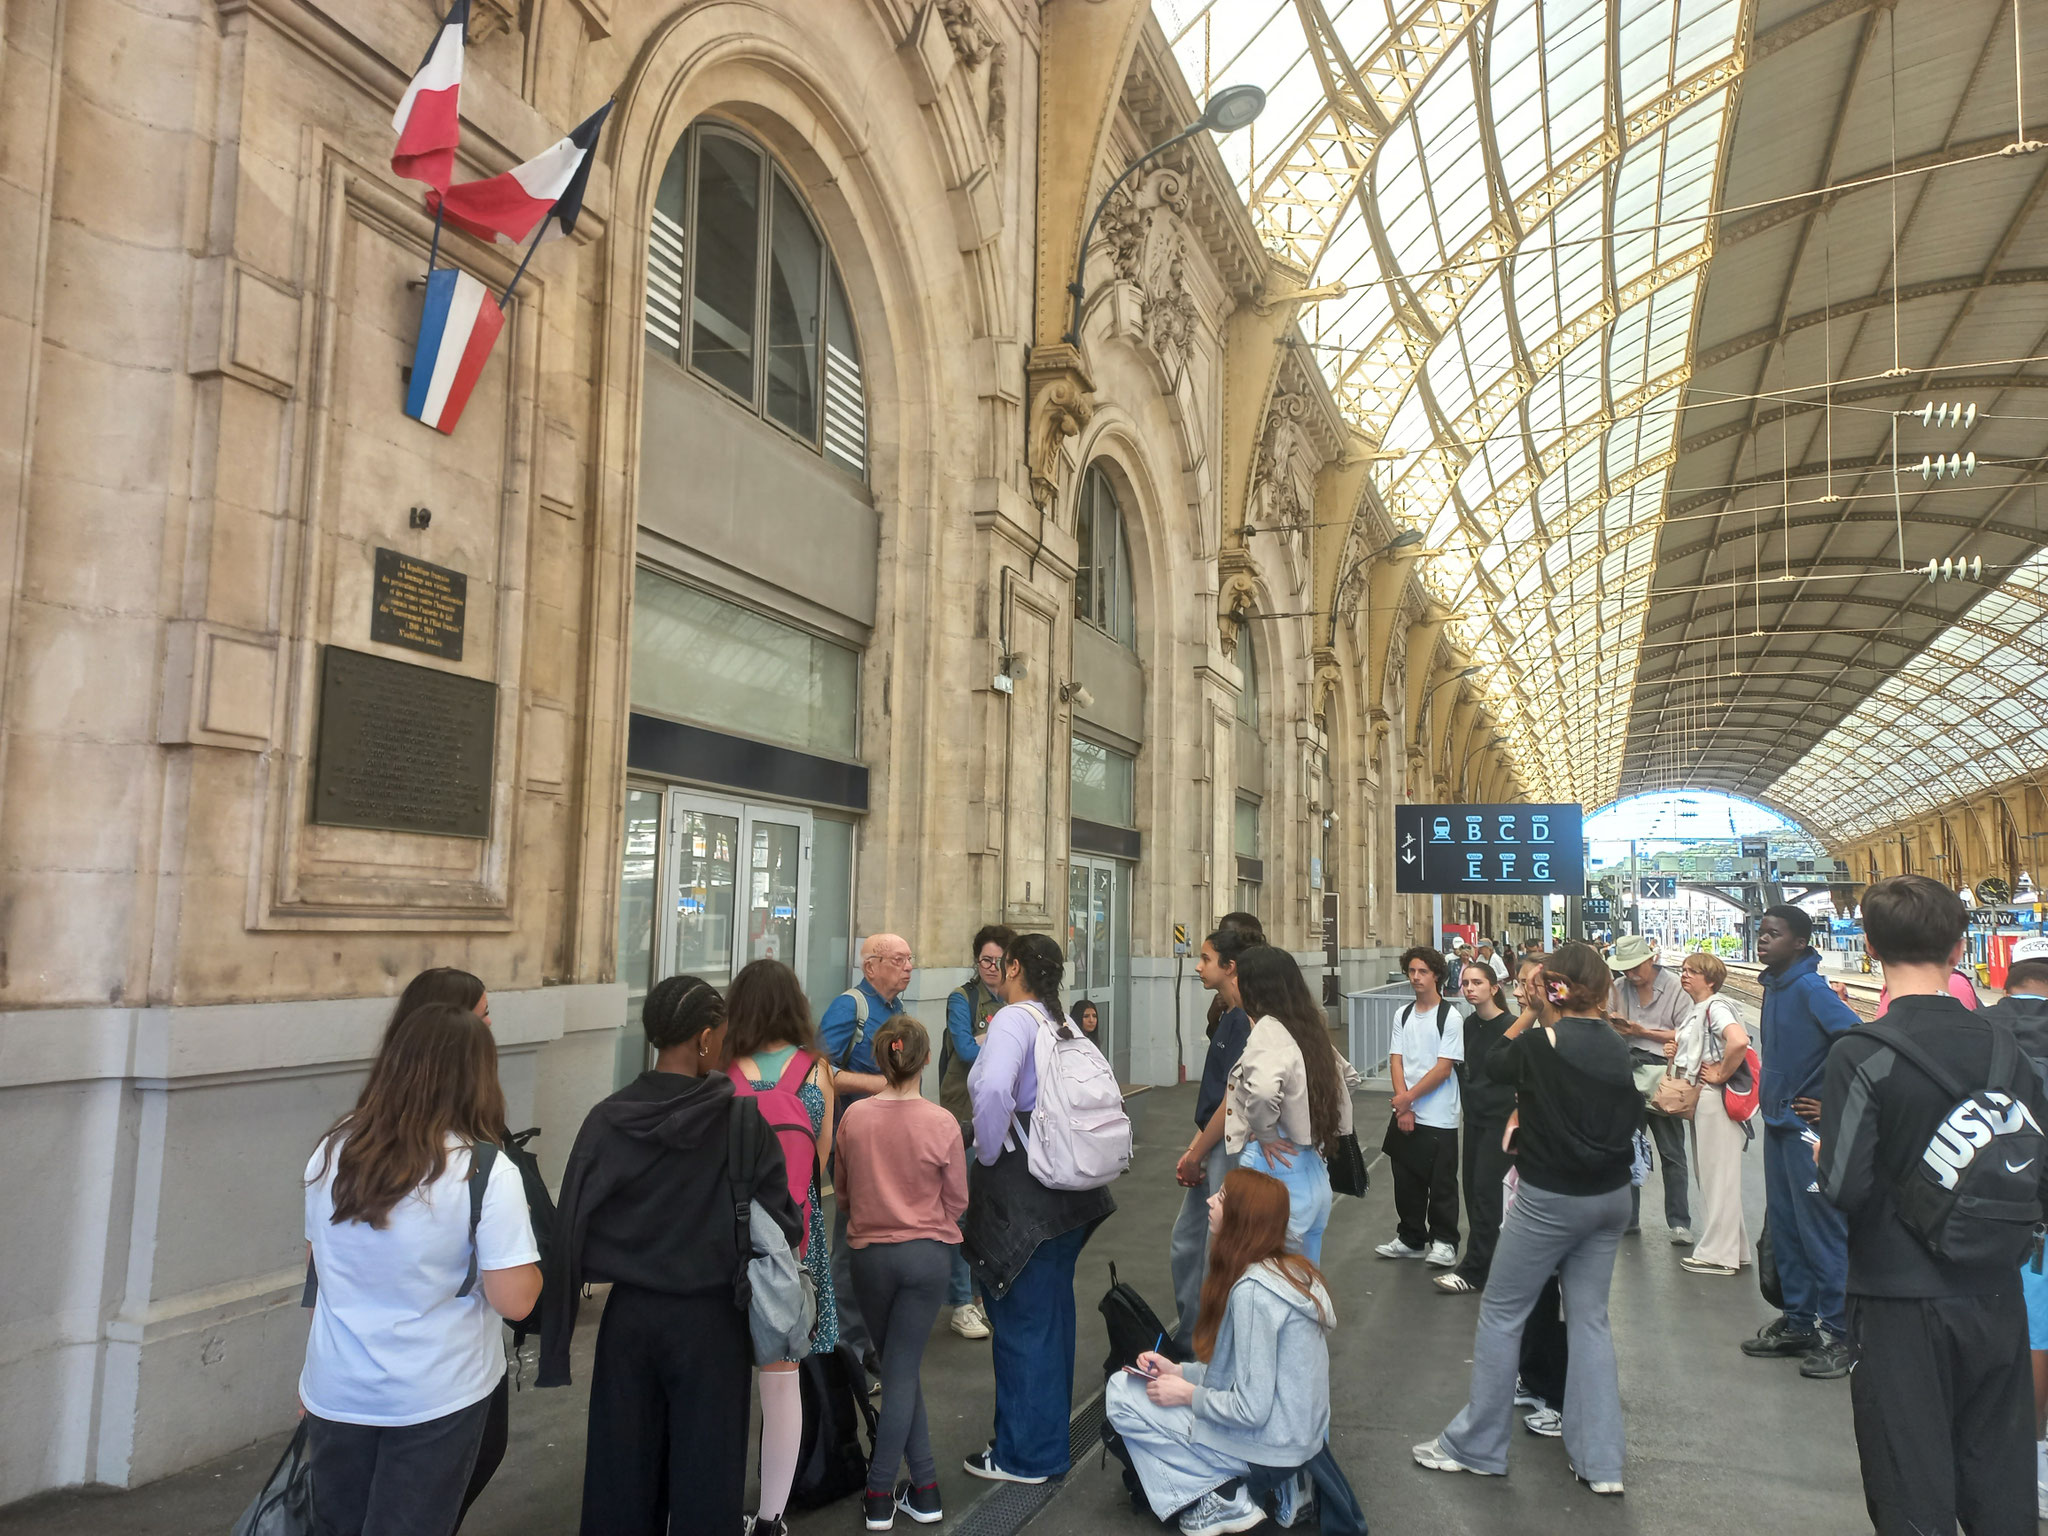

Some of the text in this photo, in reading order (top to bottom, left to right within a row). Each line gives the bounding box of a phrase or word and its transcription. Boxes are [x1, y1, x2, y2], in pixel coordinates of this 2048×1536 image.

[1468, 823, 1550, 841] B C D
[1469, 861, 1550, 880] E F G
[1646, 882, 1660, 897] X
[1976, 914, 1990, 924] W
[1998, 915, 2011, 924] W
